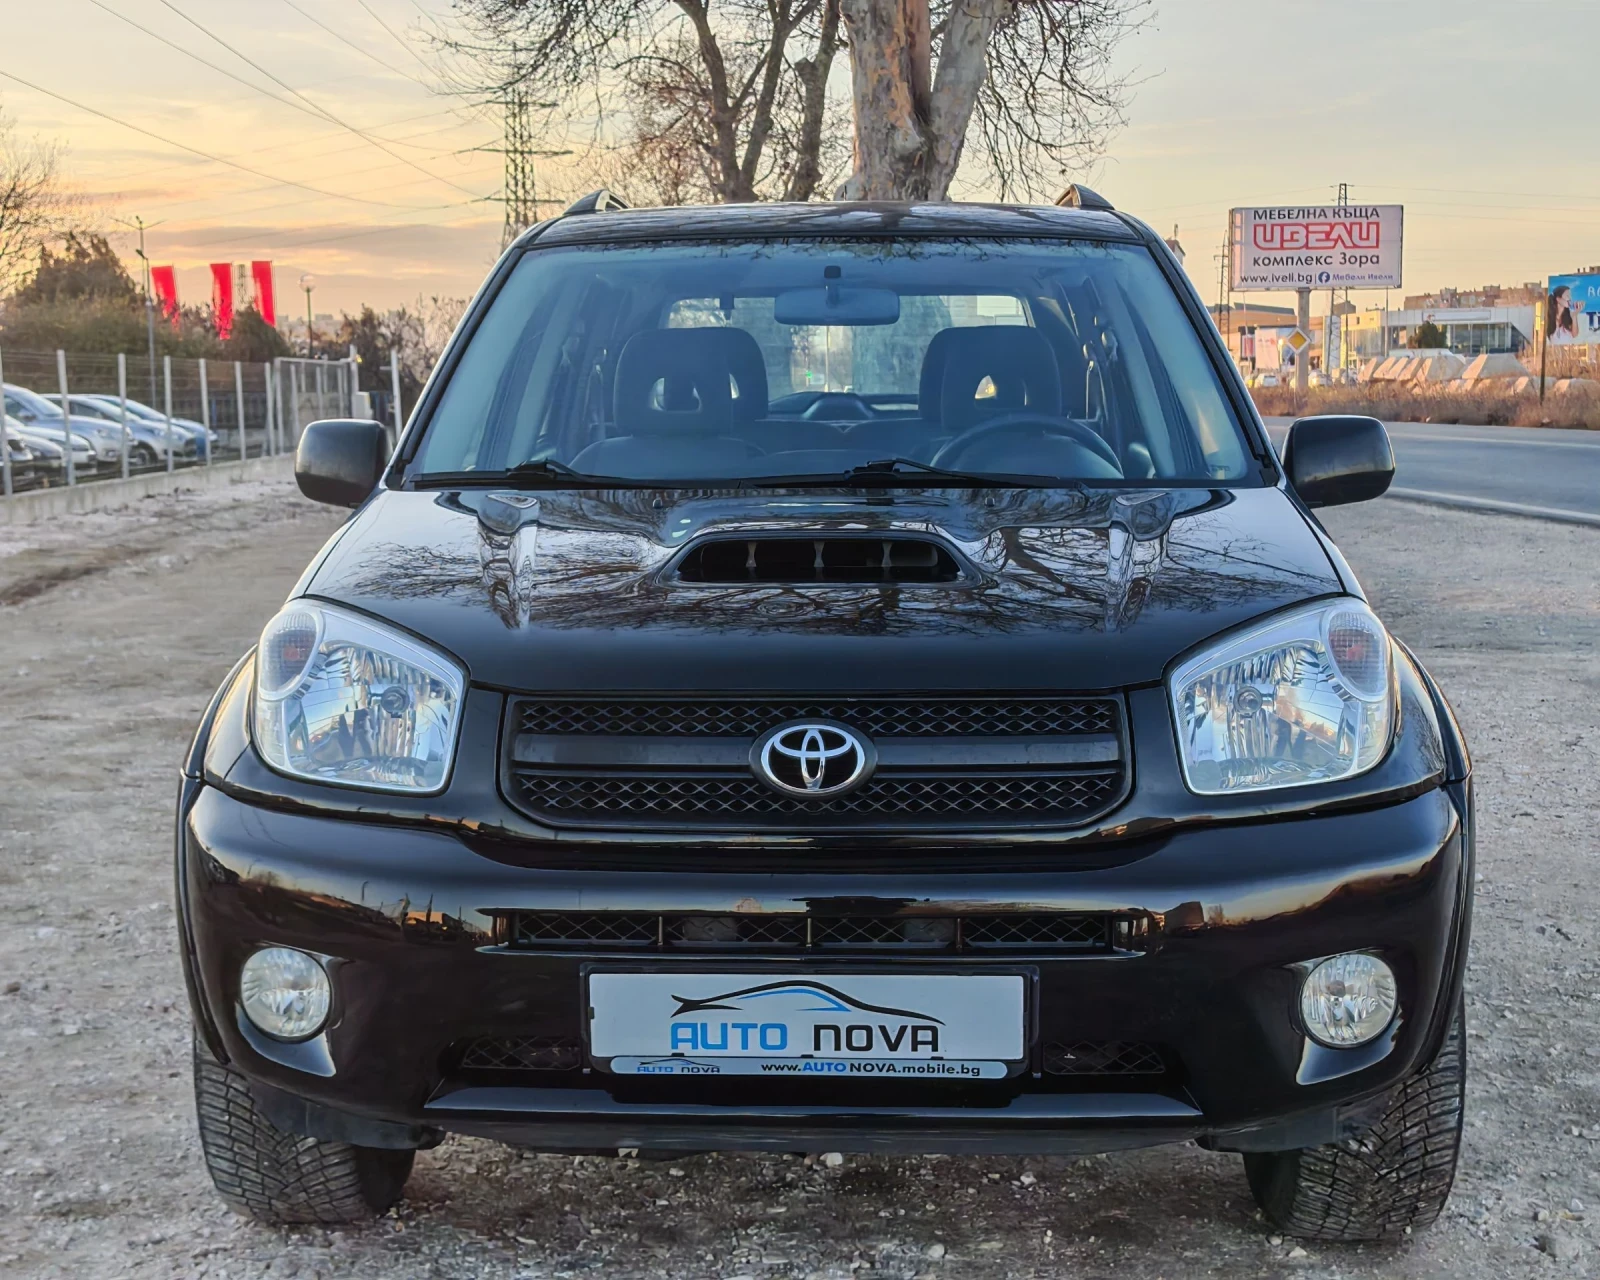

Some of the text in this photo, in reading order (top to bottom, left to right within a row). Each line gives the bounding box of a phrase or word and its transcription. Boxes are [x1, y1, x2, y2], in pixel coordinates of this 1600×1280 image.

[1253, 207, 1380, 221] МЕБЕЛНА КЪЩА
[1253, 252, 1380, 268] комплекс Зора
[670, 1022, 939, 1053] AUTO NOVA
